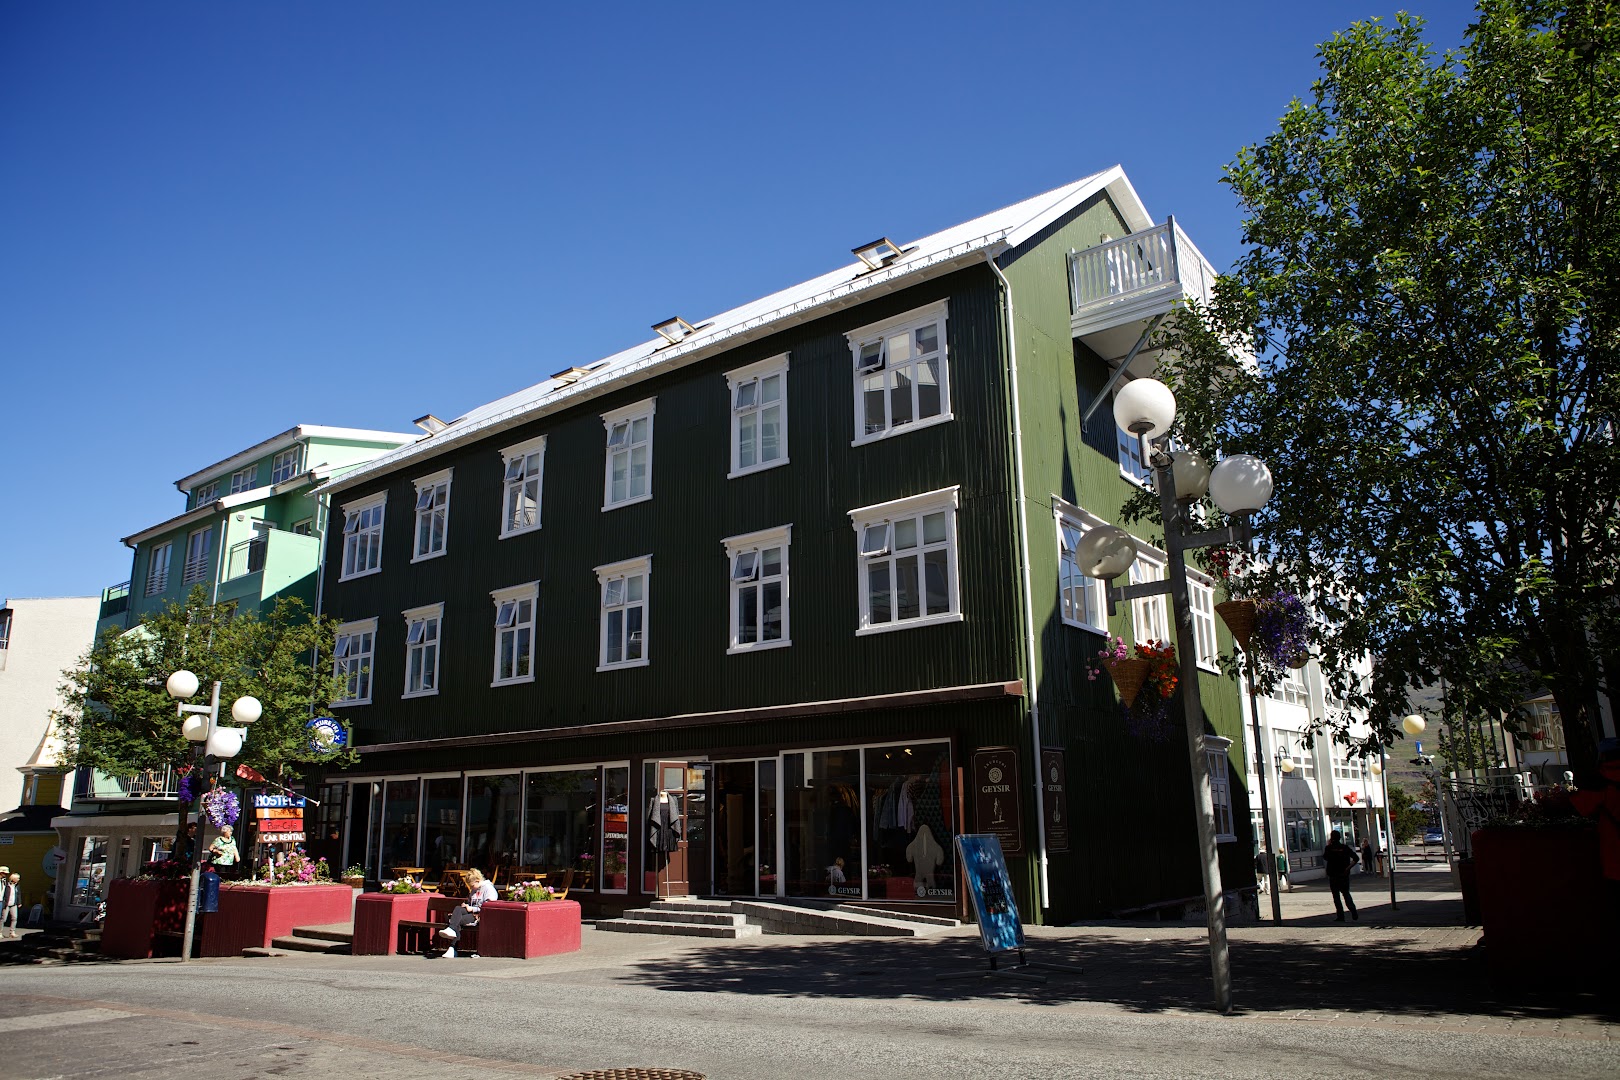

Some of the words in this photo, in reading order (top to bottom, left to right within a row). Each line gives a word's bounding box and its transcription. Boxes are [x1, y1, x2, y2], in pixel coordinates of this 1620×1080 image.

[981, 784, 1011, 794] GEYSIR
[1047, 784, 1063, 792] GEYSIR
[255, 795, 296, 806] HOSTEL
[263, 834, 278, 842] CAR
[279, 832, 305, 841] RENTAL
[837, 887, 861, 895] GEYSIR
[927, 888, 953, 896] GEYSIR
